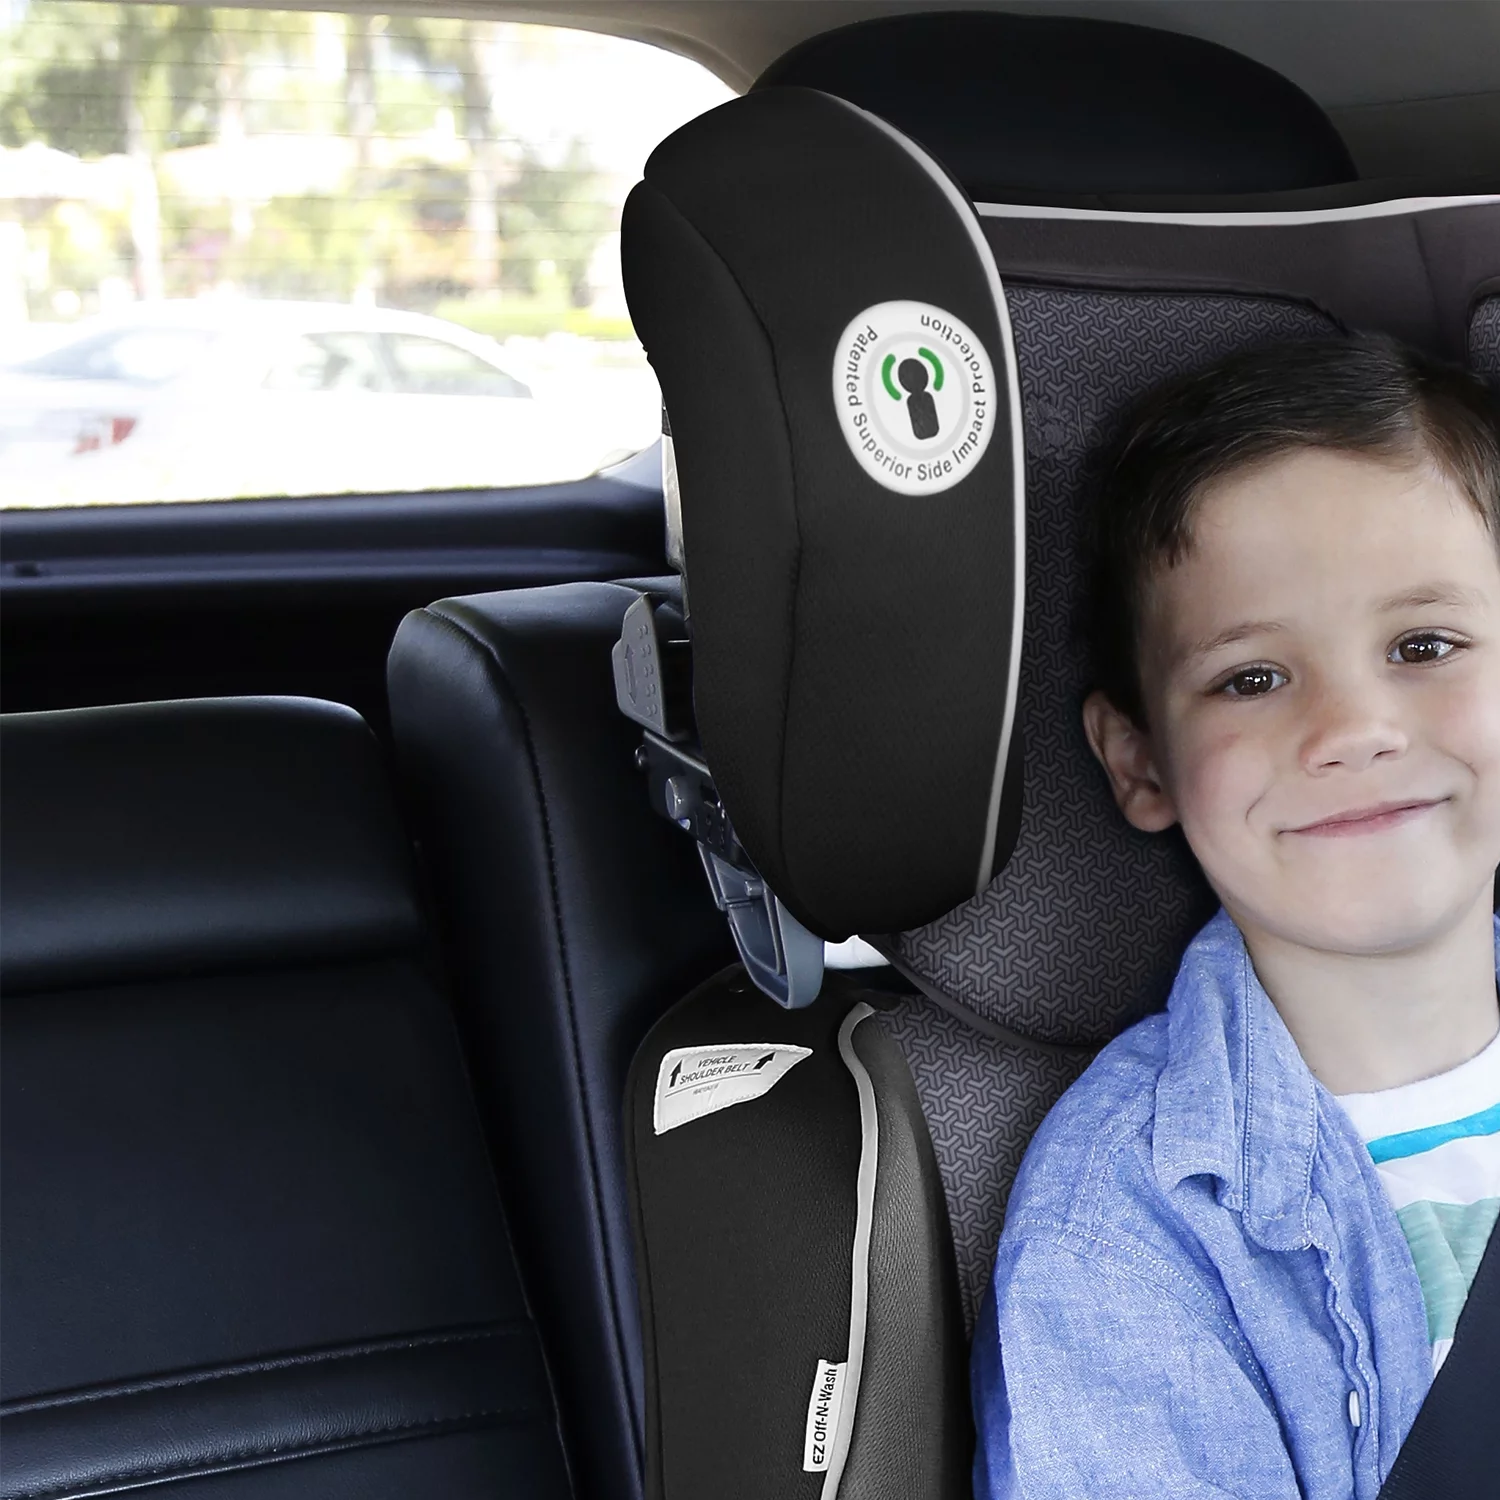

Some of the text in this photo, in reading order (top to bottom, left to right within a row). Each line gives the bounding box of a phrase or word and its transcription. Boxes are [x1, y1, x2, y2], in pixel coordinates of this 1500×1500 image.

[846, 314, 986, 481] Patented Superior Side Impact Protection
[679, 1063, 751, 1085] SHOULDER BELT
[698, 1055, 737, 1068] VEHICLE
[812, 1368, 837, 1465] EZ Off-N-Wash
